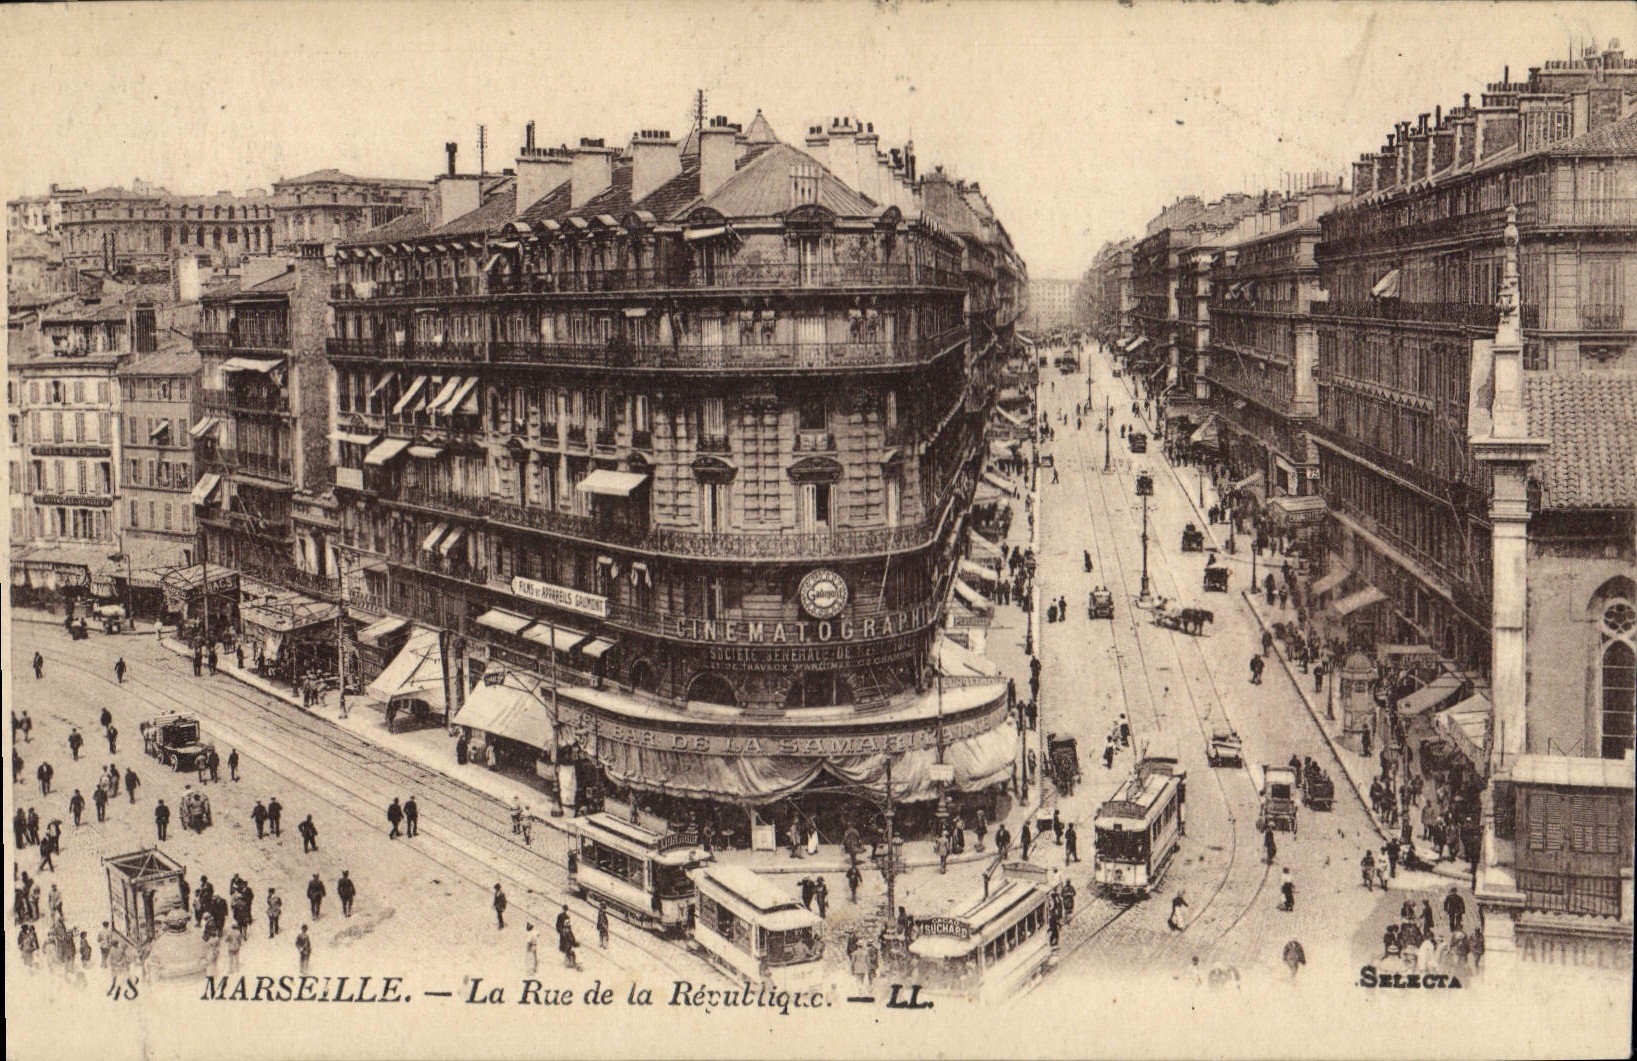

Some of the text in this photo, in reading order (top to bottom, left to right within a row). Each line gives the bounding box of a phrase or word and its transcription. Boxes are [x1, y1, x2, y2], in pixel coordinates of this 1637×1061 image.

[518, 581, 534, 595] FILMS
[541, 586, 572, 605] APPAREILS
[574, 594, 604, 612] GAUMONT
[612, 725, 658, 747] BAR
[671, 735, 710, 753] DE
[721, 737, 762, 755] LA
[924, 923, 968, 939] SUCHARD
